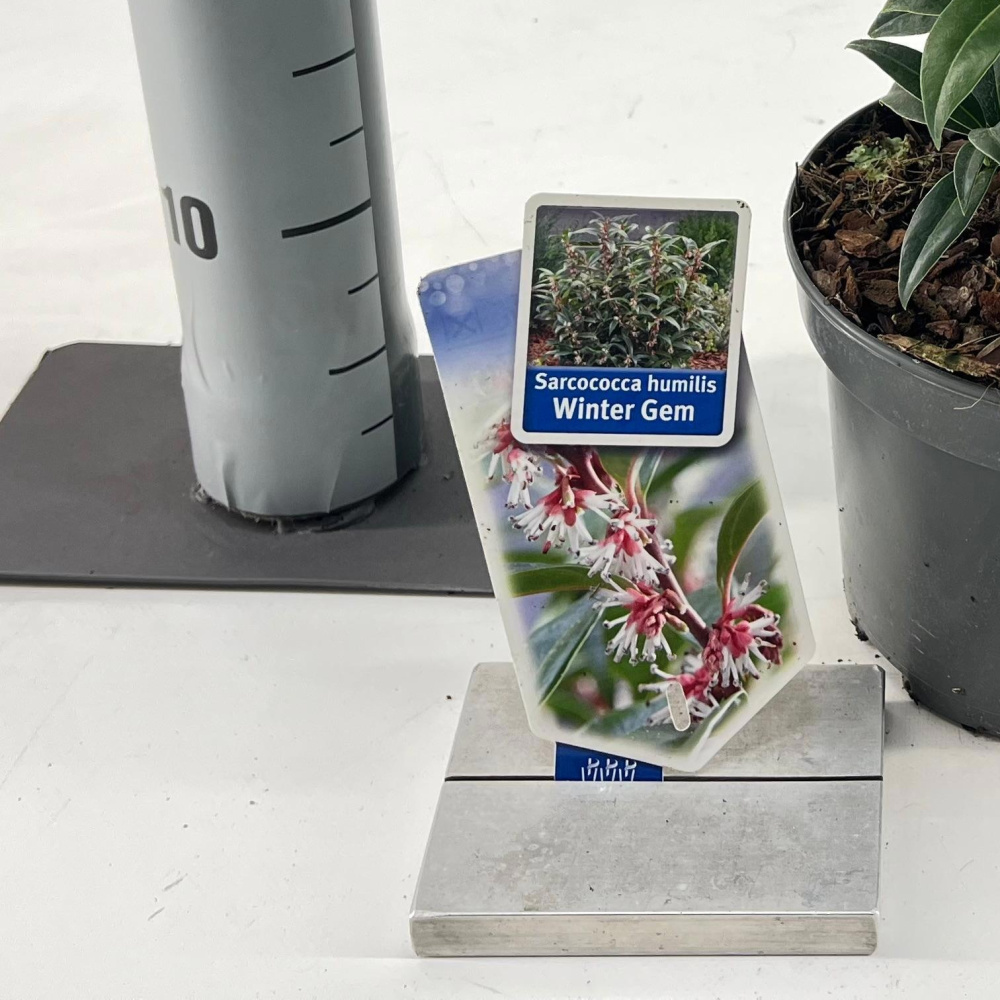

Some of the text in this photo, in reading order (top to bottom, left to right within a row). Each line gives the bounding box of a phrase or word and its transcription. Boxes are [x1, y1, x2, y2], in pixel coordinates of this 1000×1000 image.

[160, 185, 218, 260] 10
[534, 372, 717, 393] Sarcococca humilis
[552, 397, 695, 421] Winter Gem
